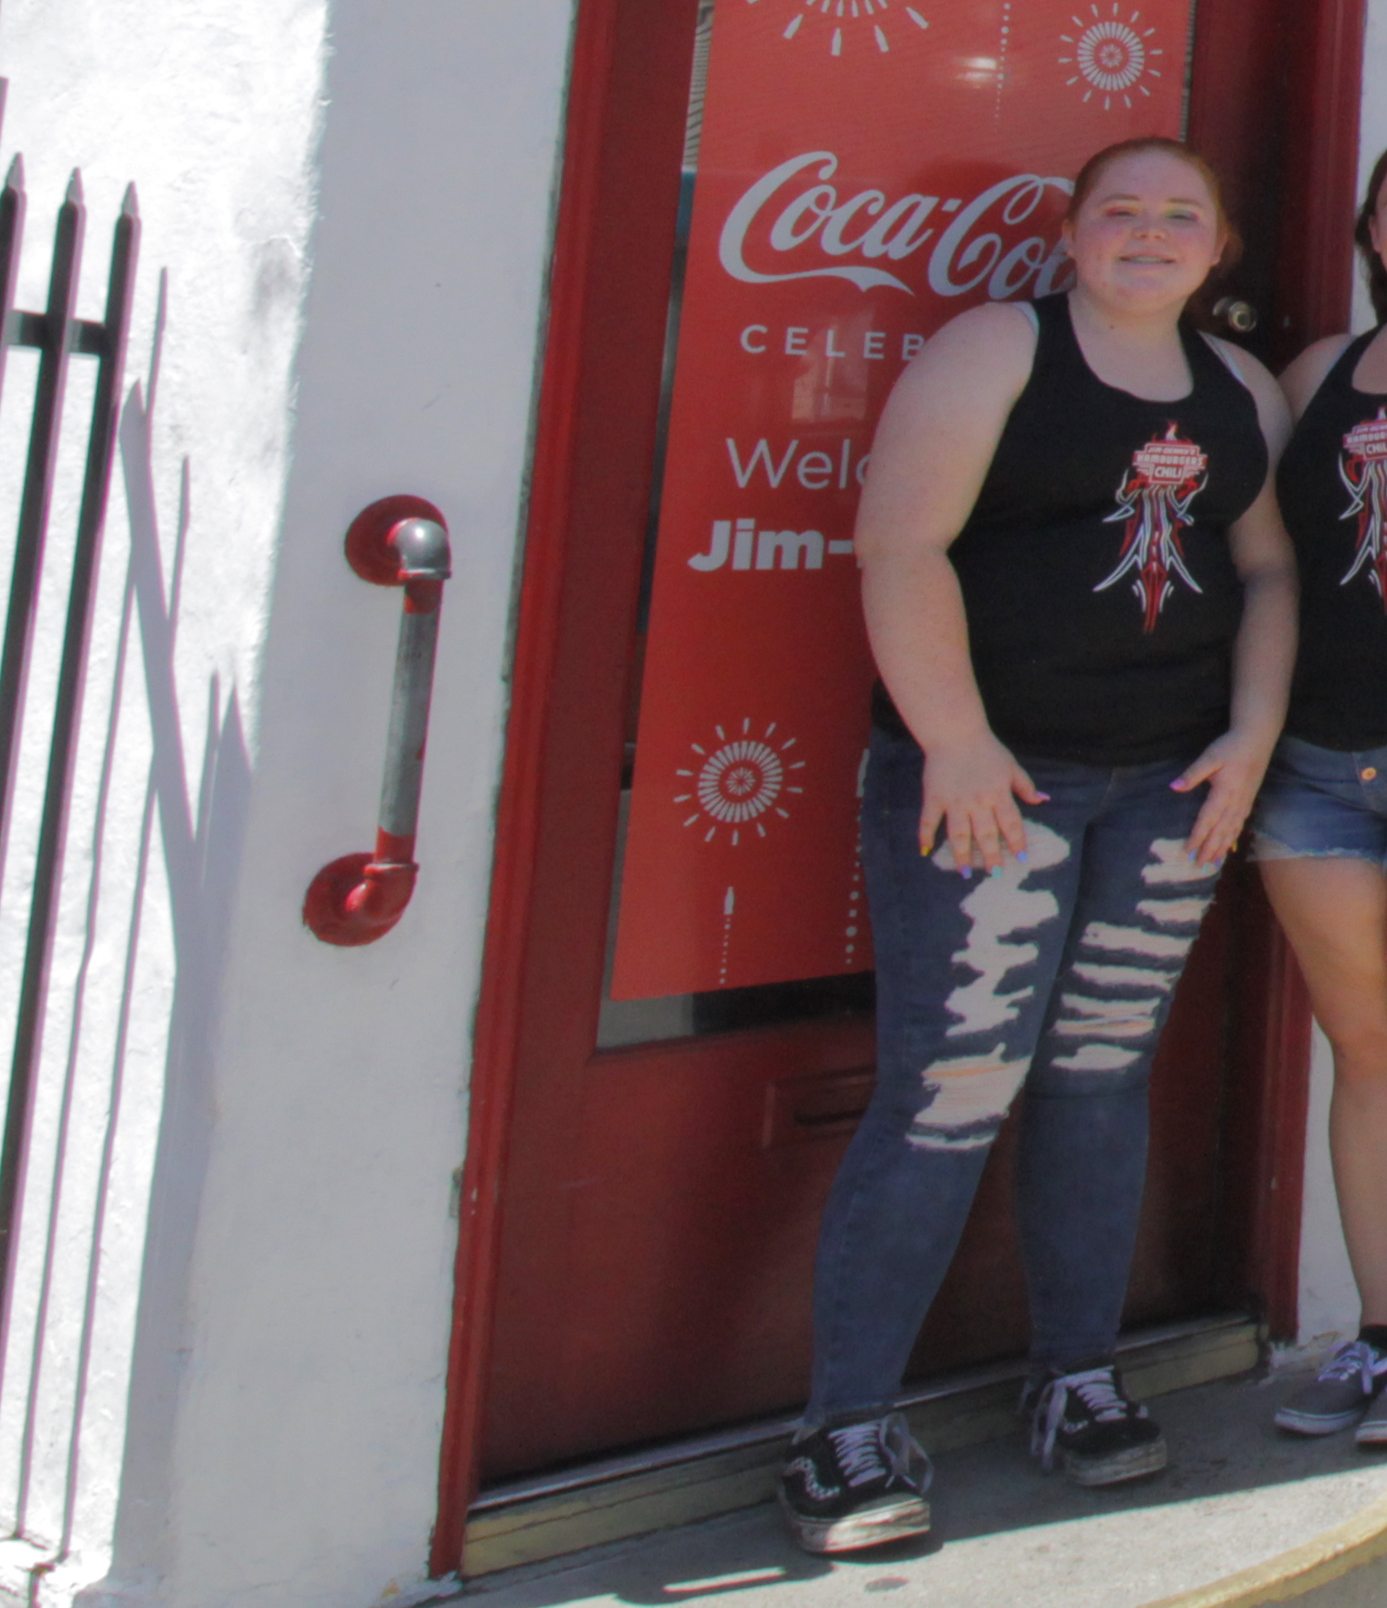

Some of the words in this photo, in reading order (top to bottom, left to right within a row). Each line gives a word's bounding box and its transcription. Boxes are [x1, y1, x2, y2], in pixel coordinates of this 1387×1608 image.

[740, 324, 925, 361] CELEB
[1154, 465, 1183, 479] CHILI
[687, 518, 862, 572] Jim-
